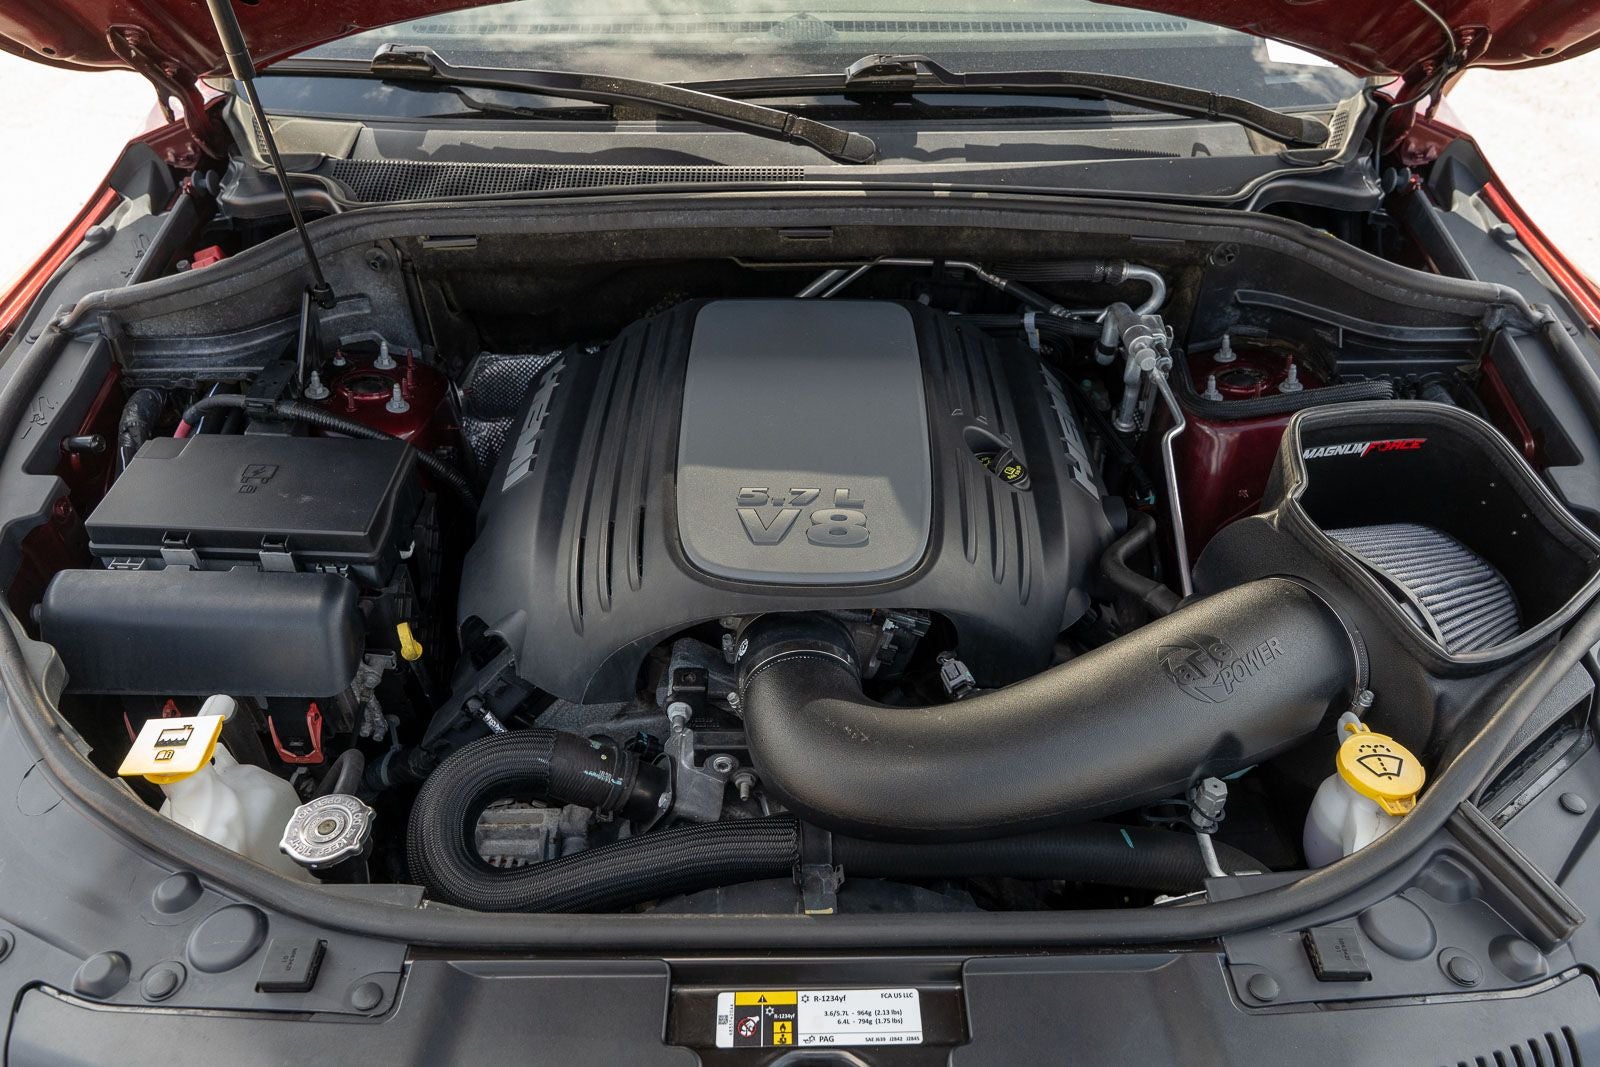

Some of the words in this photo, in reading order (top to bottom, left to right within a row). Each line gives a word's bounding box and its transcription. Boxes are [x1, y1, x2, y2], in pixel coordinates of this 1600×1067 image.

[736, 508, 870, 548] V8
[1219, 636, 1286, 695] POWER
[313, 796, 343, 809] OPEN
[813, 994, 847, 1002] R-1234yf
[891, 1008, 903, 1016] lbs)
[875, 1017, 891, 1025] (1.75
[891, 1017, 904, 1025] lbs)
[819, 1035, 835, 1043] PAG
